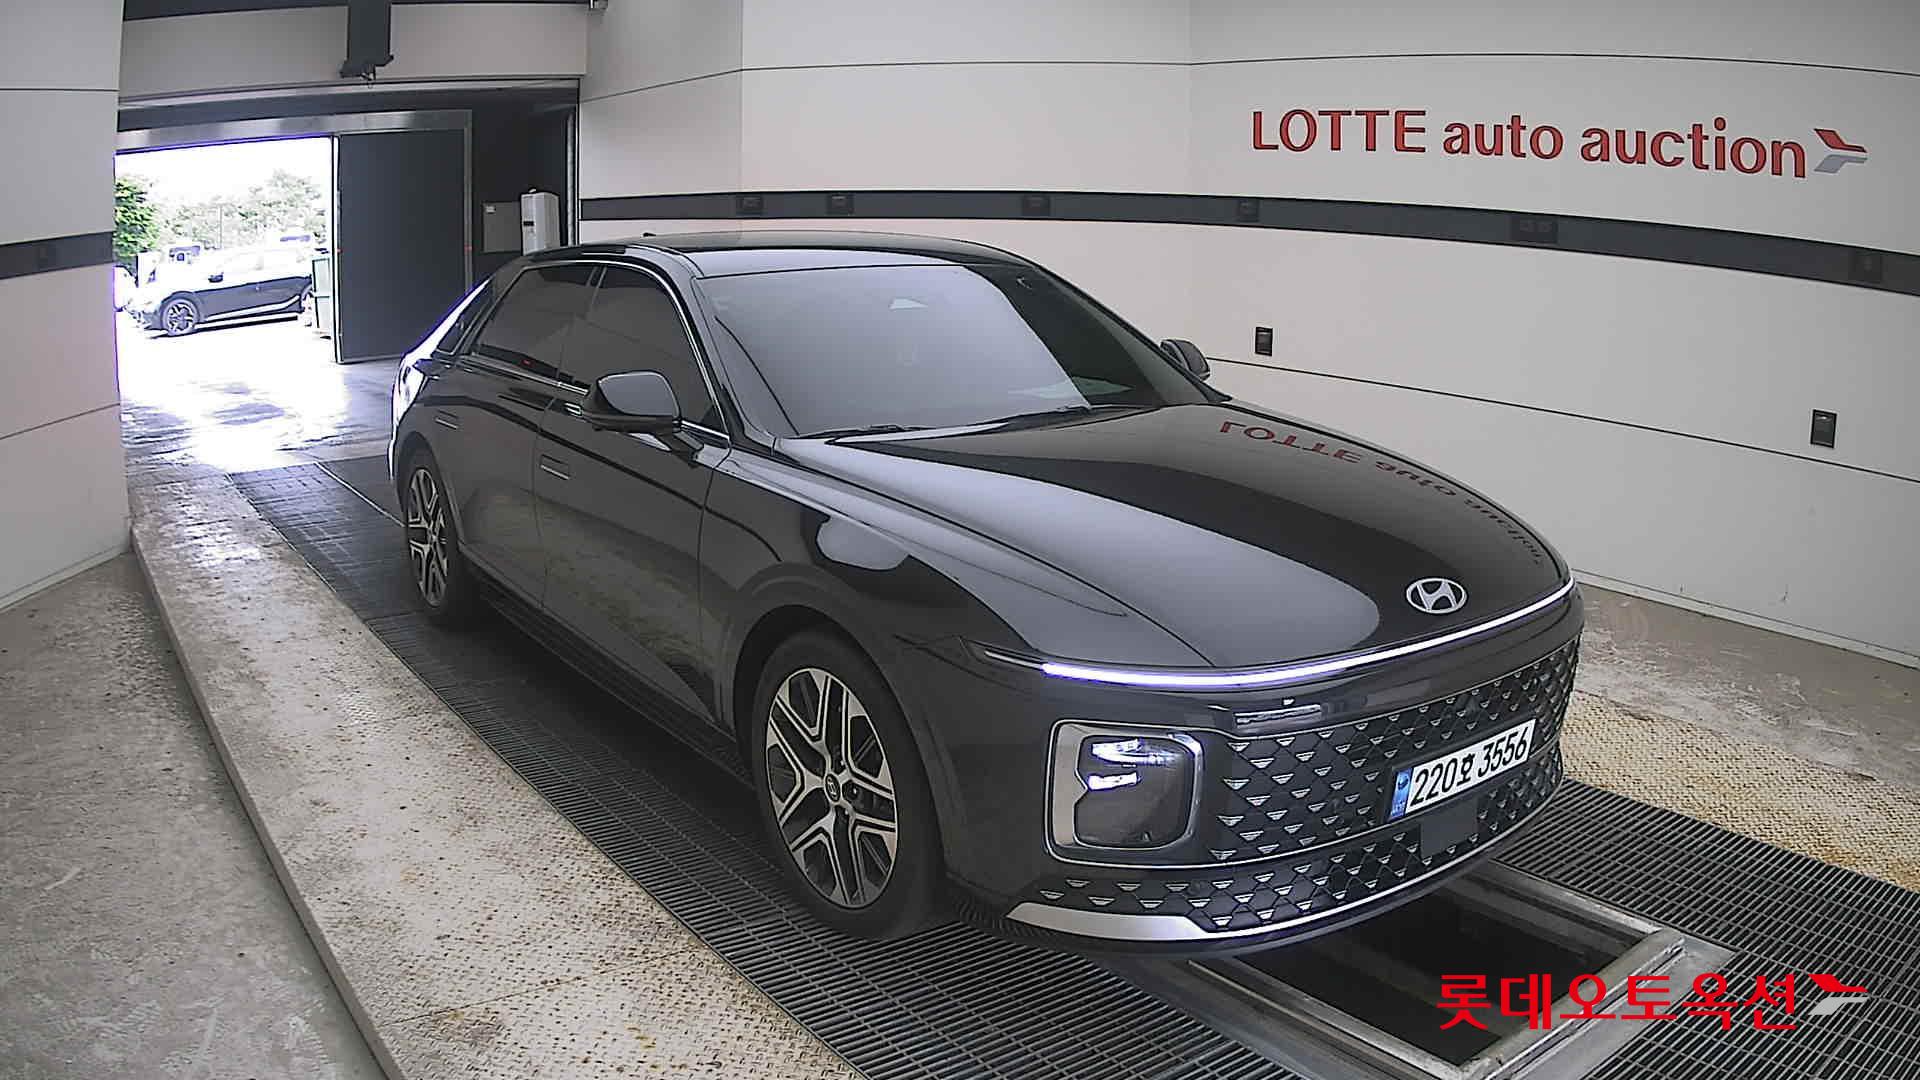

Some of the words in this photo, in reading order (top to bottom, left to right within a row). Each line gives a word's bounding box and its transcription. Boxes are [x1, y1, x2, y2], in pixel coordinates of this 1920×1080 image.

[1253, 110, 1426, 153] LOTTE
[1443, 115, 1564, 159] auto
[1581, 117, 1806, 178] auction
[1410, 753, 1475, 806] 220호
[1478, 727, 1528, 777] 3556
